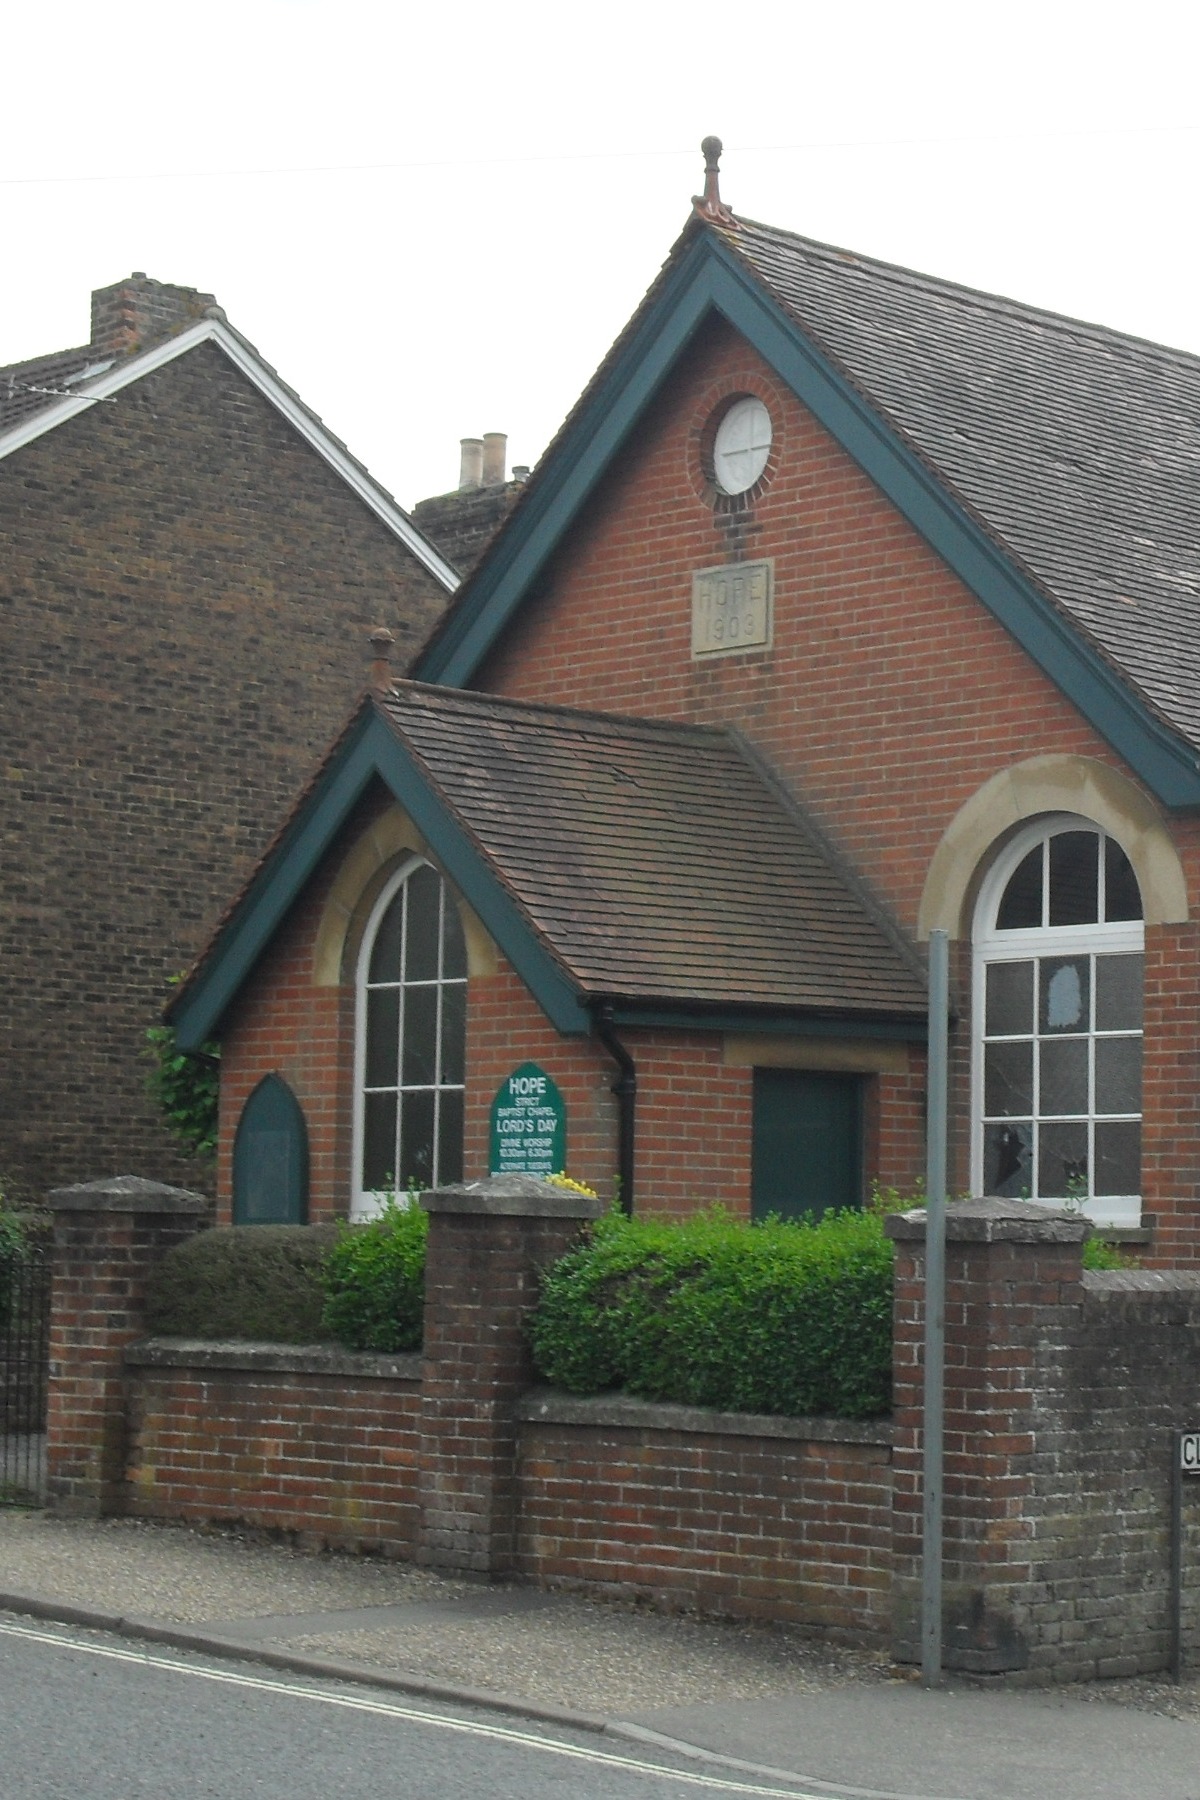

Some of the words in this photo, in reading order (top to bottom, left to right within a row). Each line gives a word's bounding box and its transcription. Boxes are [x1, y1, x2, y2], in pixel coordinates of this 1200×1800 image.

[699, 574, 761, 610] HOPE
[509, 1077, 547, 1095] HOPE
[515, 1097, 540, 1106] STRICT
[497, 1107, 526, 1117] BAPTIST
[496, 1120, 534, 1133] LORD'S
[537, 1119, 558, 1132] DAY
[500, 1138, 521, 1147] DIVINE
[523, 1138, 552, 1147] WORSHIP
